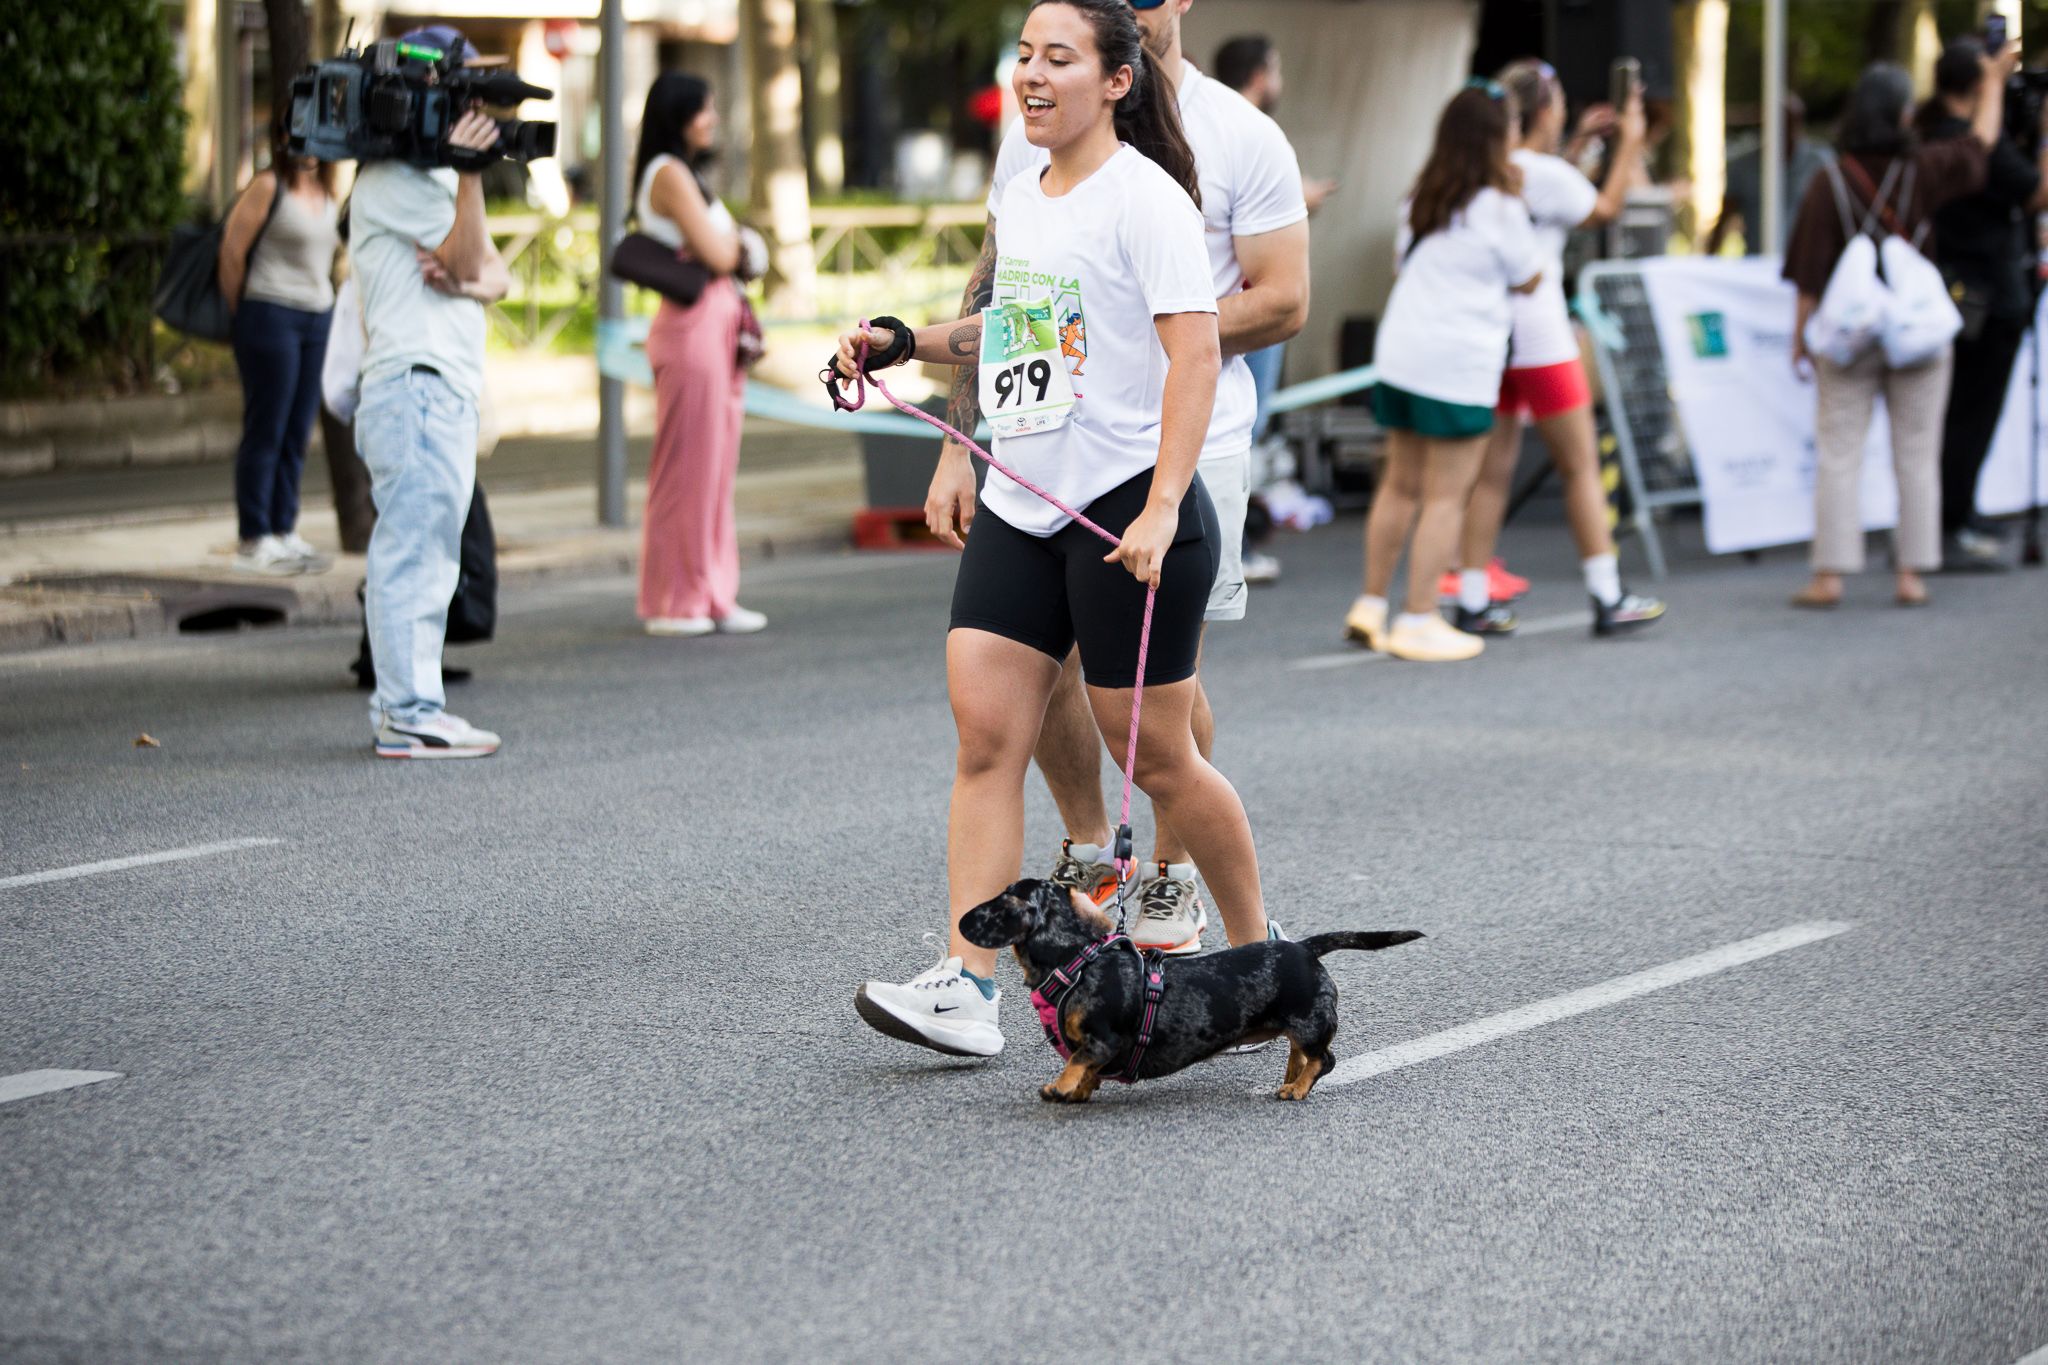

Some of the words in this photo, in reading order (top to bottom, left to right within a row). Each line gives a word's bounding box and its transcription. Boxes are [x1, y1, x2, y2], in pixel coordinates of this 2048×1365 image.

[1032, 272, 1057, 287] CON
[1059, 276, 1080, 290] LA
[995, 359, 1051, 409] 979
